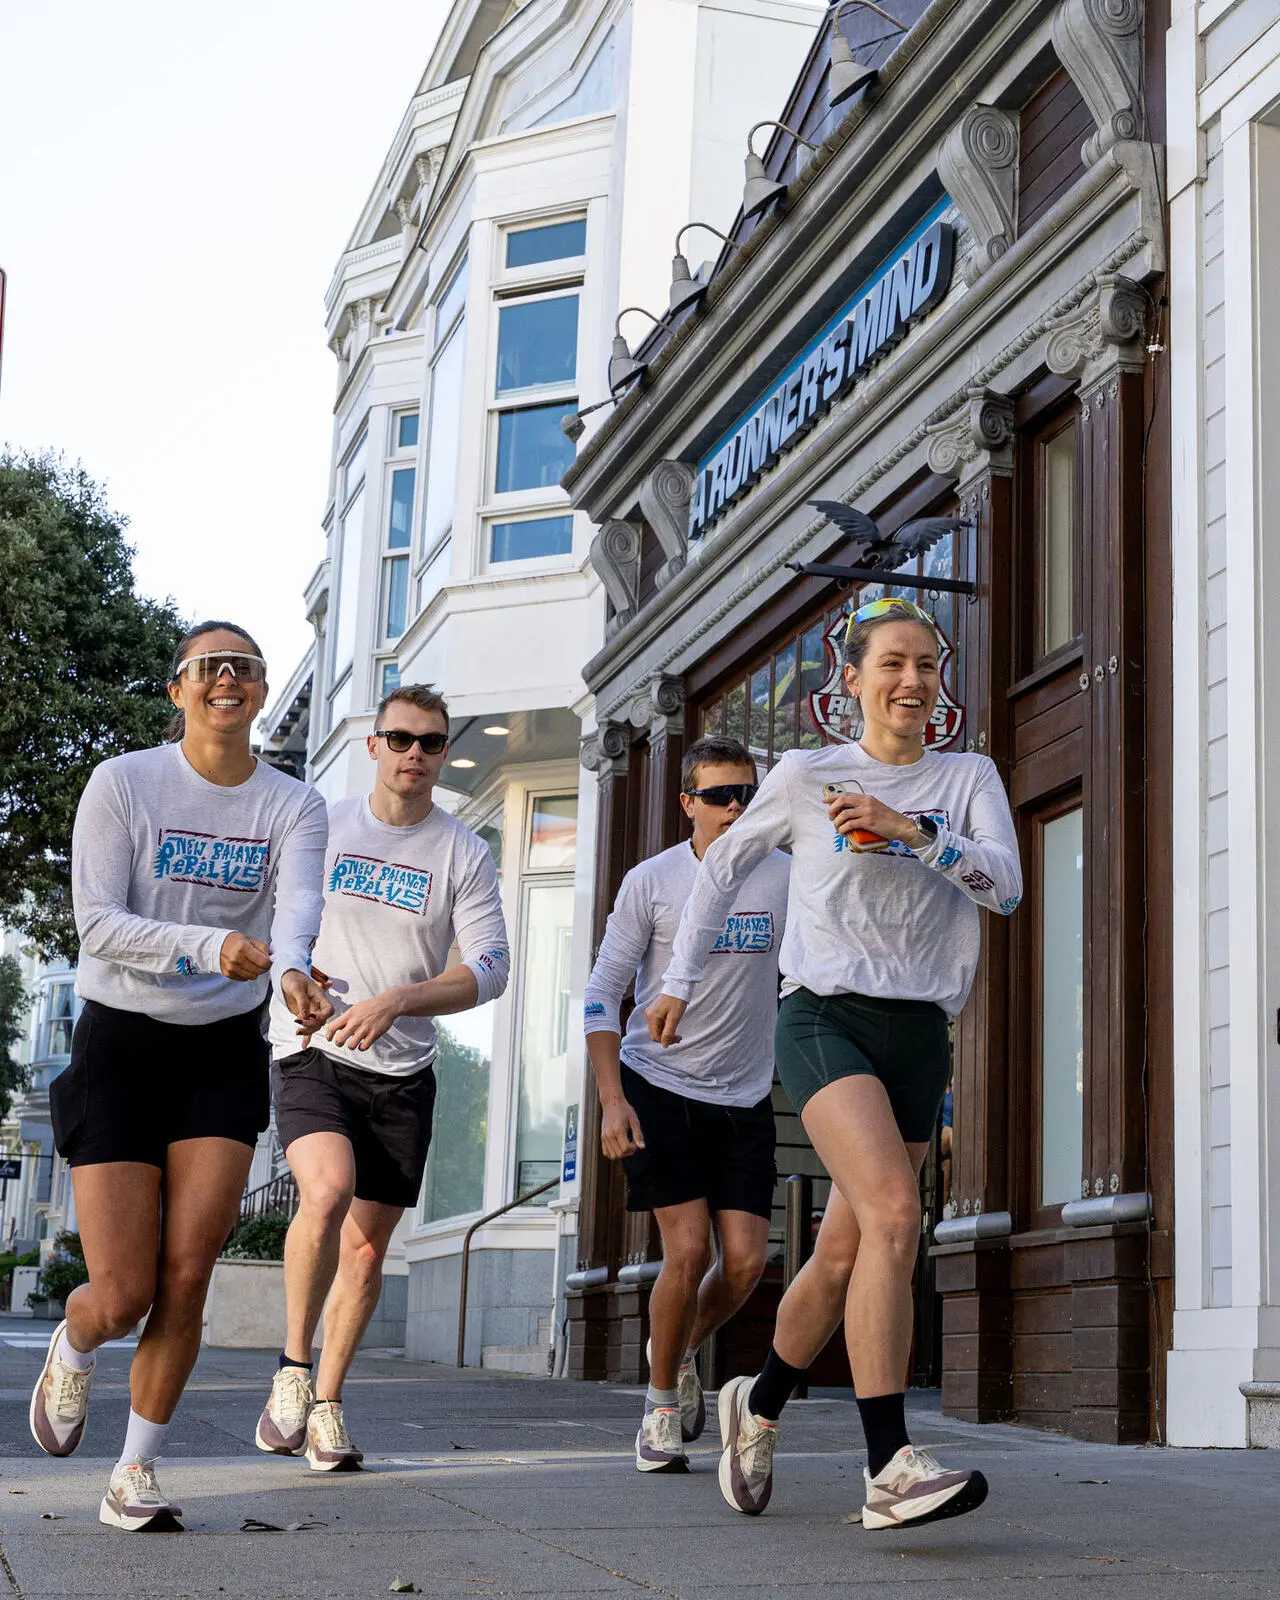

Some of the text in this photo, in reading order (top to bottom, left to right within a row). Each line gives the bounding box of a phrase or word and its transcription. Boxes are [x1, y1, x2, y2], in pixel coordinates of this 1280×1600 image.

[690, 222, 948, 533] A RUNNER'S MIND
[170, 837, 268, 865] NEW BALANCE
[345, 860, 428, 891] NEW BALANCE
[726, 917, 770, 933] BALANCE
